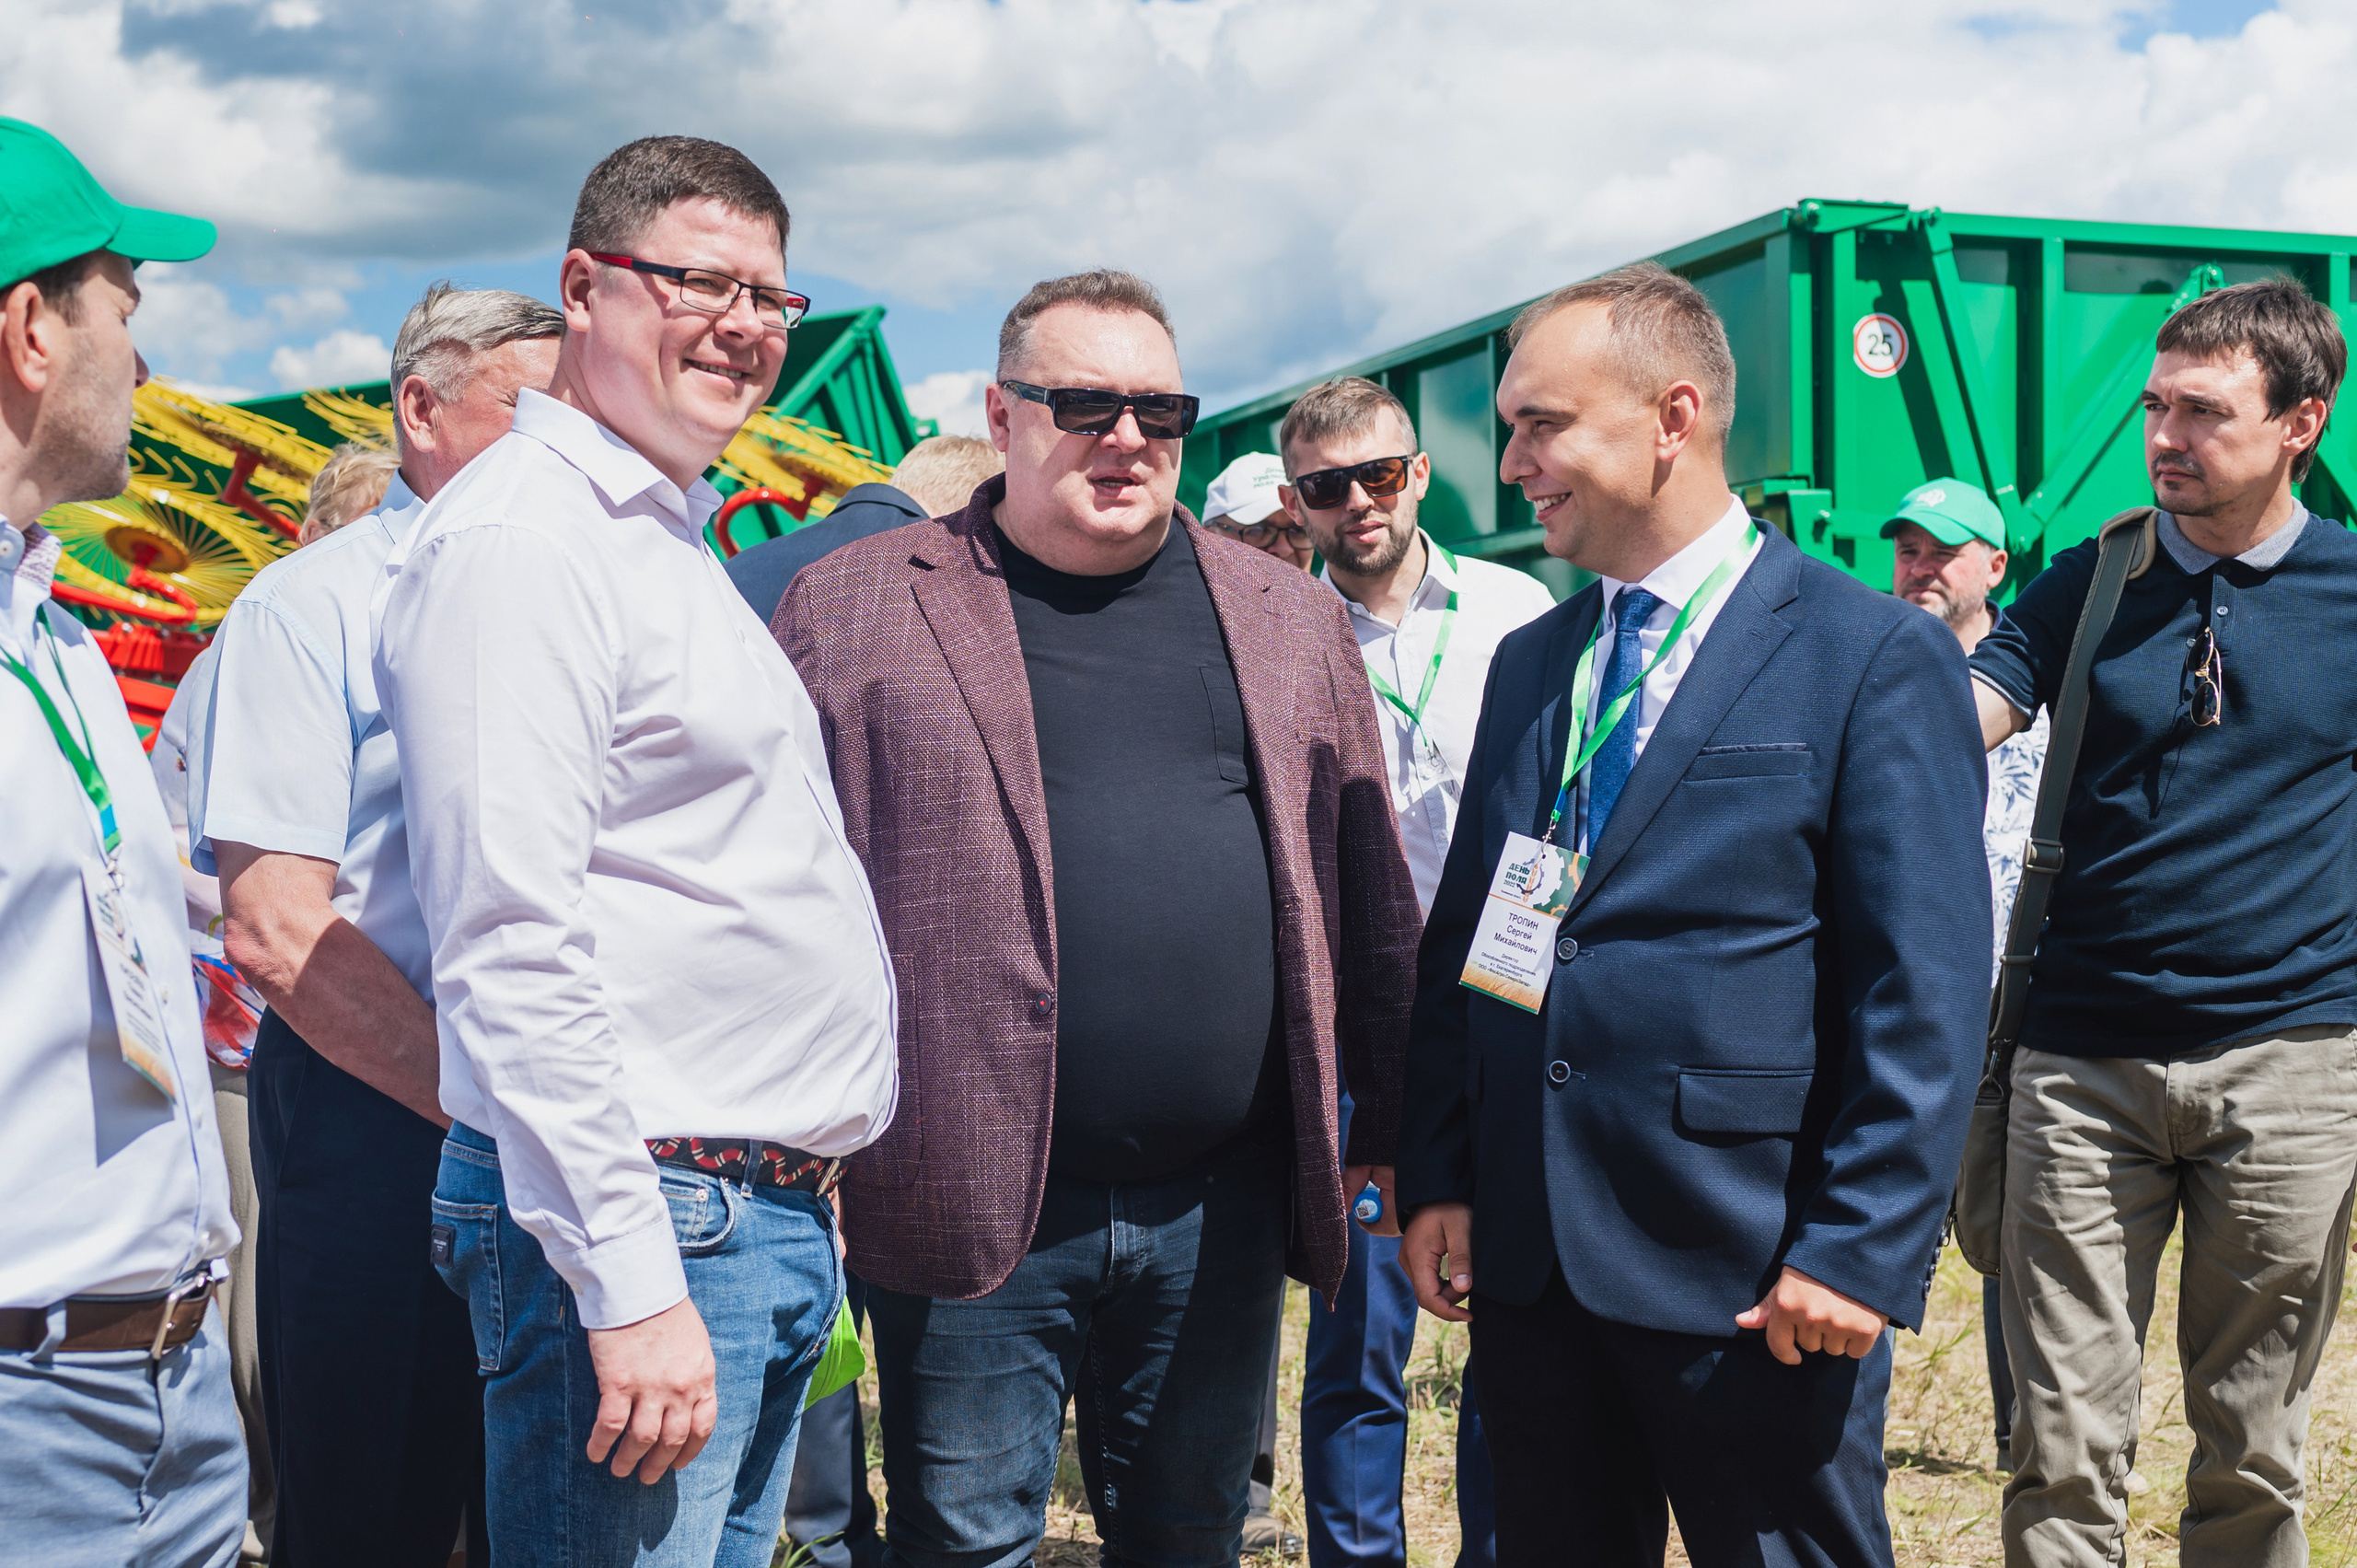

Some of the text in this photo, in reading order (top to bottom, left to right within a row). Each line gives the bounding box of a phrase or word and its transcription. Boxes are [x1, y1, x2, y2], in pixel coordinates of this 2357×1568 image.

[1867, 333, 1892, 357] 25
[1505, 871, 1527, 885] ПОЛЯ
[1508, 863, 1530, 876] ДЕНЬ
[1503, 879, 1515, 888] 2022
[1508, 912, 1538, 931] ТРОПИН
[1506, 924, 1532, 941] Сергей
[1493, 932, 1538, 955] Михайлович
